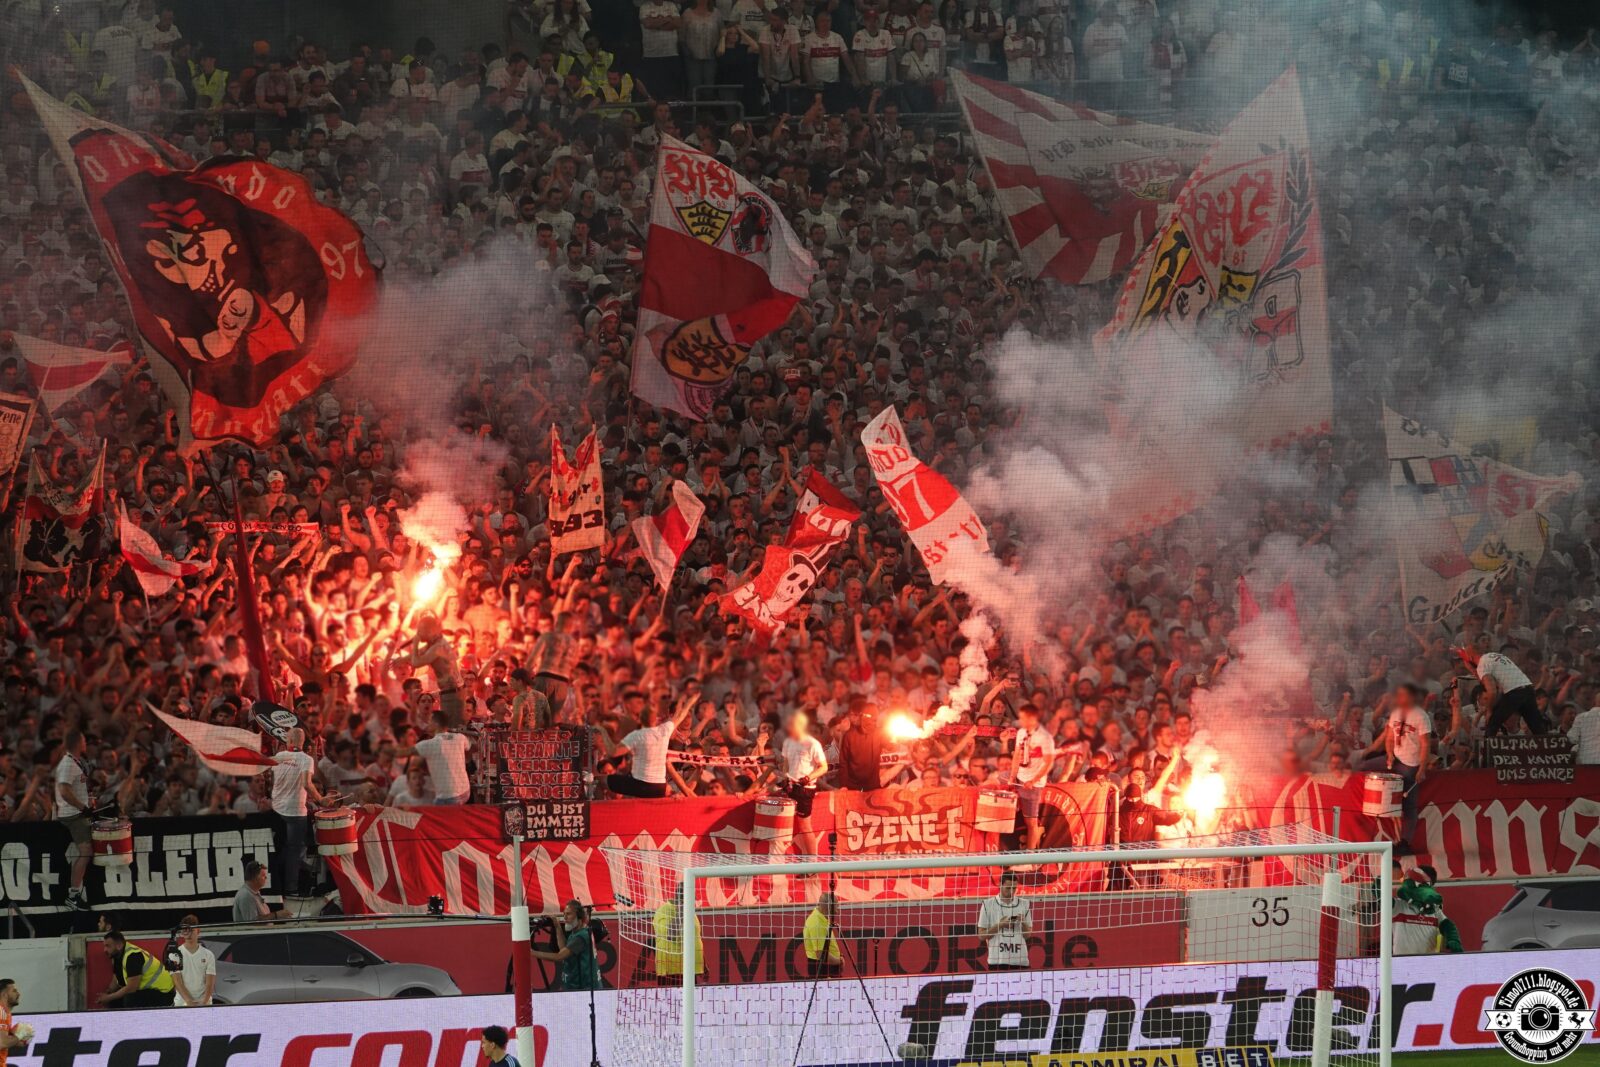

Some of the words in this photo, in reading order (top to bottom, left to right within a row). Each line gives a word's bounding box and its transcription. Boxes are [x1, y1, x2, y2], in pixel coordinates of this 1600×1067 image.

[319, 238, 364, 282] 97
[507, 730, 572, 743] JEDER
[1489, 737, 1538, 750] ULTRA
[1543, 737, 1569, 749] IST
[499, 740, 580, 759] VERBANNTE
[507, 758, 573, 772] KEHRT
[1493, 754, 1522, 766] DER
[1527, 753, 1572, 766] KAMPF
[1496, 767, 1527, 781] UMS
[1529, 767, 1574, 780] GANZE
[526, 804, 547, 816] DU
[552, 803, 585, 815] BIST
[526, 815, 585, 829] IMMER
[846, 809, 940, 852] SZENE
[946, 805, 965, 849] E
[526, 829, 547, 839] BEI
[553, 827, 585, 838] UNS!
[103, 827, 276, 898] BLEIBT
[1251, 896, 1290, 927] 35
[999, 941, 1022, 954] SMF
